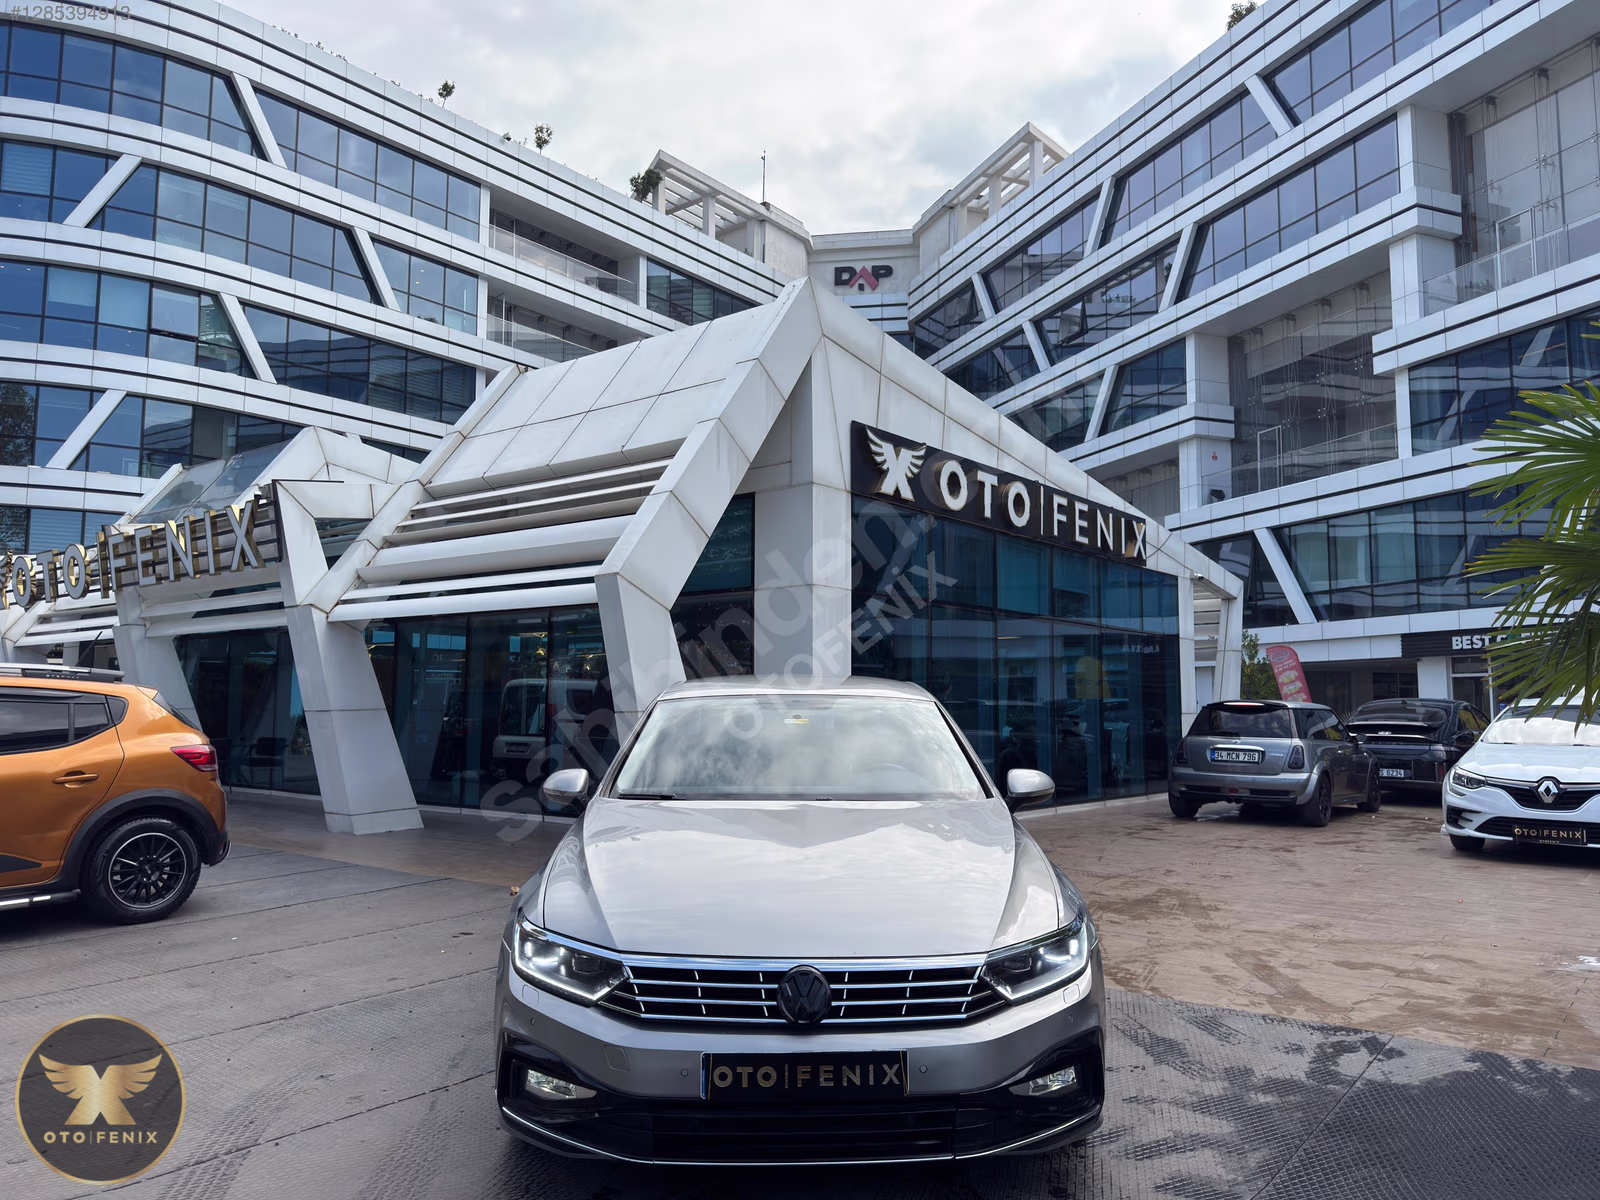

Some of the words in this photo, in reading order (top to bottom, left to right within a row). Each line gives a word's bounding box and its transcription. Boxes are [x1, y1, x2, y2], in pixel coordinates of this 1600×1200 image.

[1052, 493, 1147, 560] FENIX
[107, 500, 263, 591] FENIX
[1451, 634, 1492, 650] BEST
[1214, 751, 1224, 760] 34
[1243, 752, 1257, 761] 796
[1543, 829, 1582, 839] FENIX
[796, 1063, 900, 1087] FENIX
